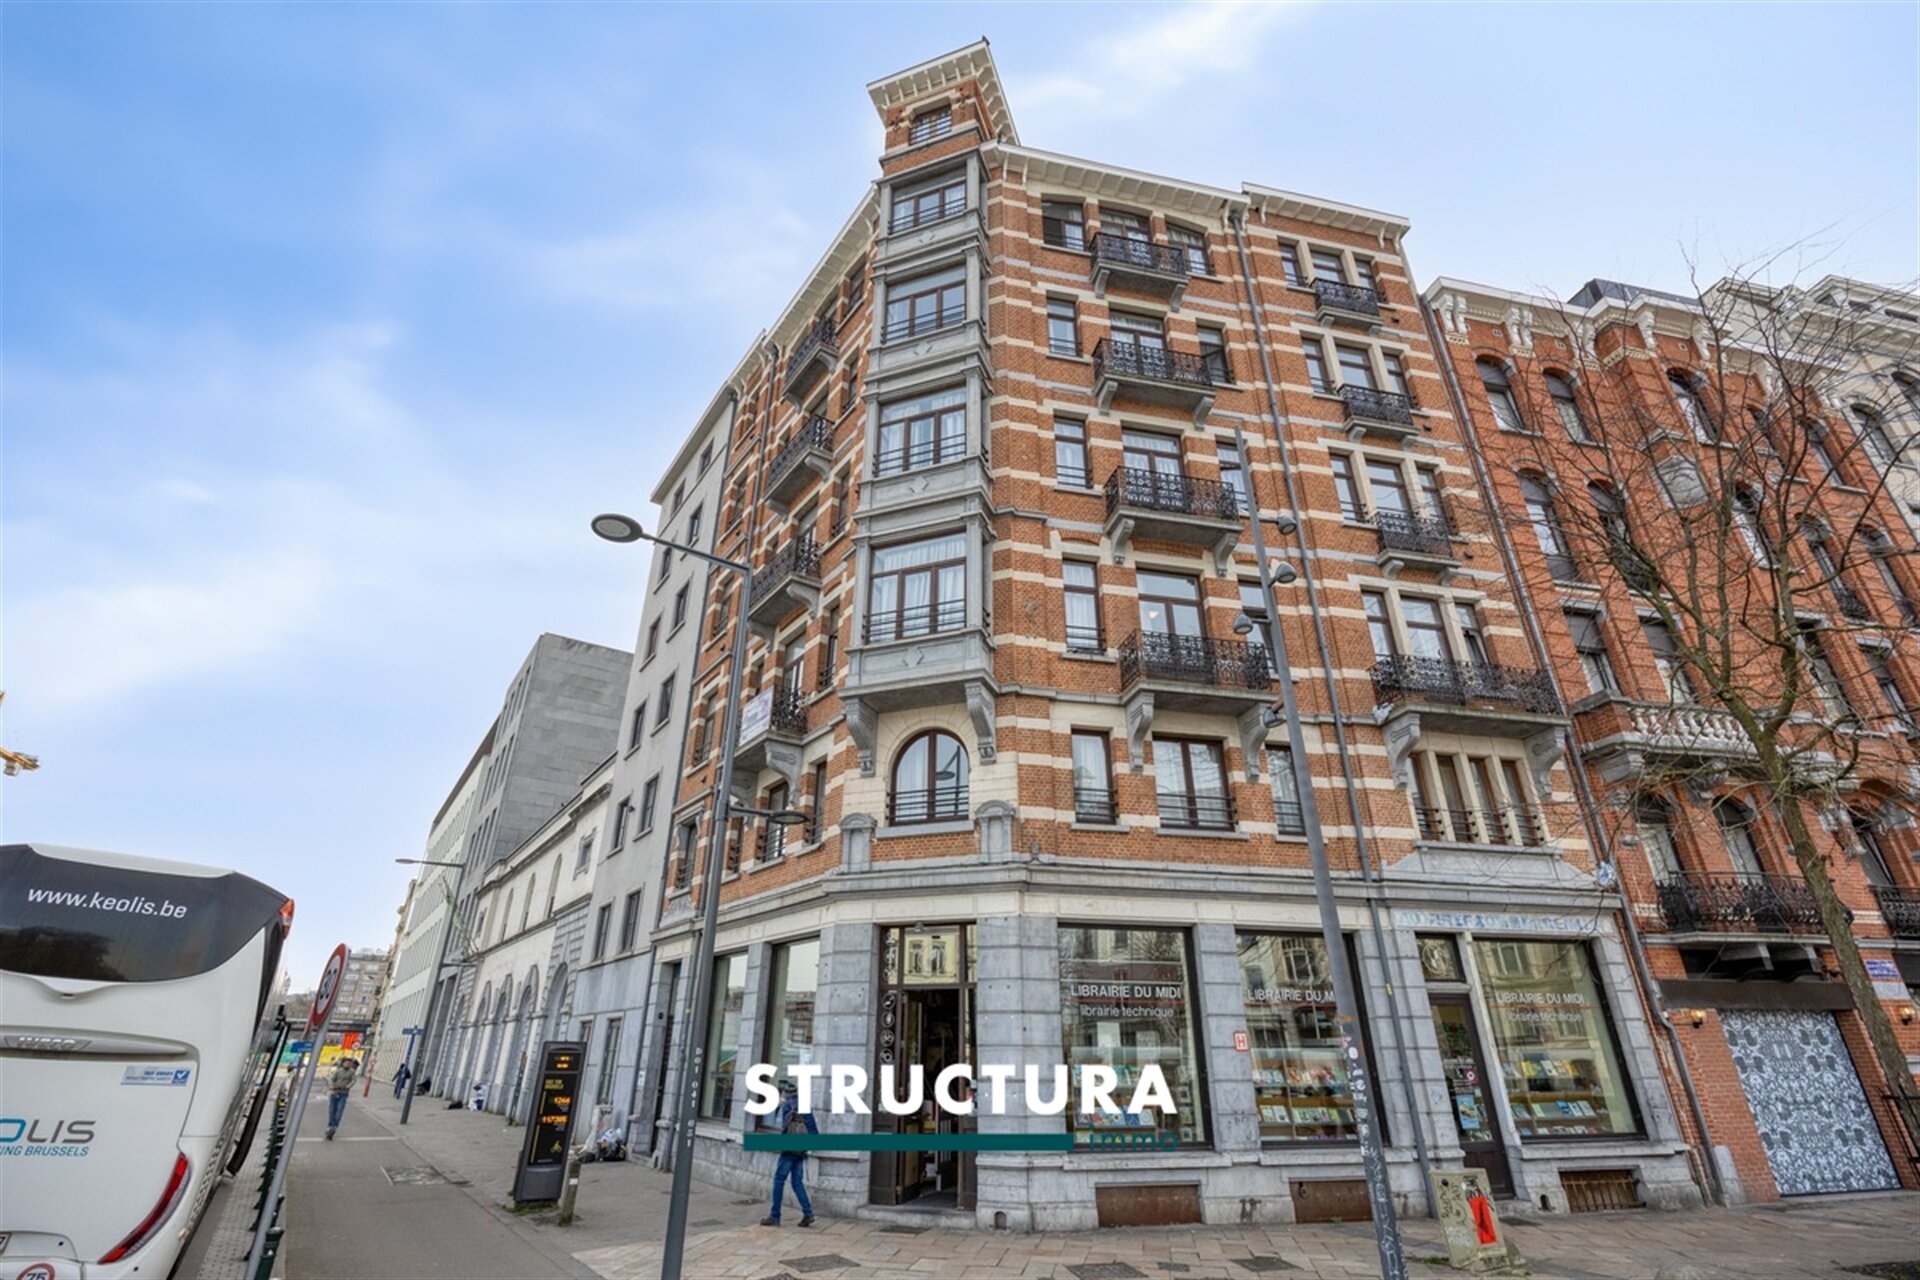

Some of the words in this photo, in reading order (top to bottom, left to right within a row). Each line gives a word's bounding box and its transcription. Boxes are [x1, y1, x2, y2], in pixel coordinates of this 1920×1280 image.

[27, 888, 188, 918] www.keolis.be
[1070, 984, 1131, 998] LIBRAIRIE
[1134, 986, 1152, 998] DU
[1156, 986, 1181, 999] MIDI
[1247, 989, 1302, 1001] LIBRAIRIE
[1305, 989, 1322, 1001] DU
[1495, 992, 1545, 1004] LIBRAIRIE
[1546, 992, 1561, 1004] DU
[1563, 992, 1585, 1004] MIDI
[1080, 1004, 1120, 1017] librairie
[1122, 1004, 1174, 1020] technique
[24, 1145, 90, 1157] BRUSSELS
